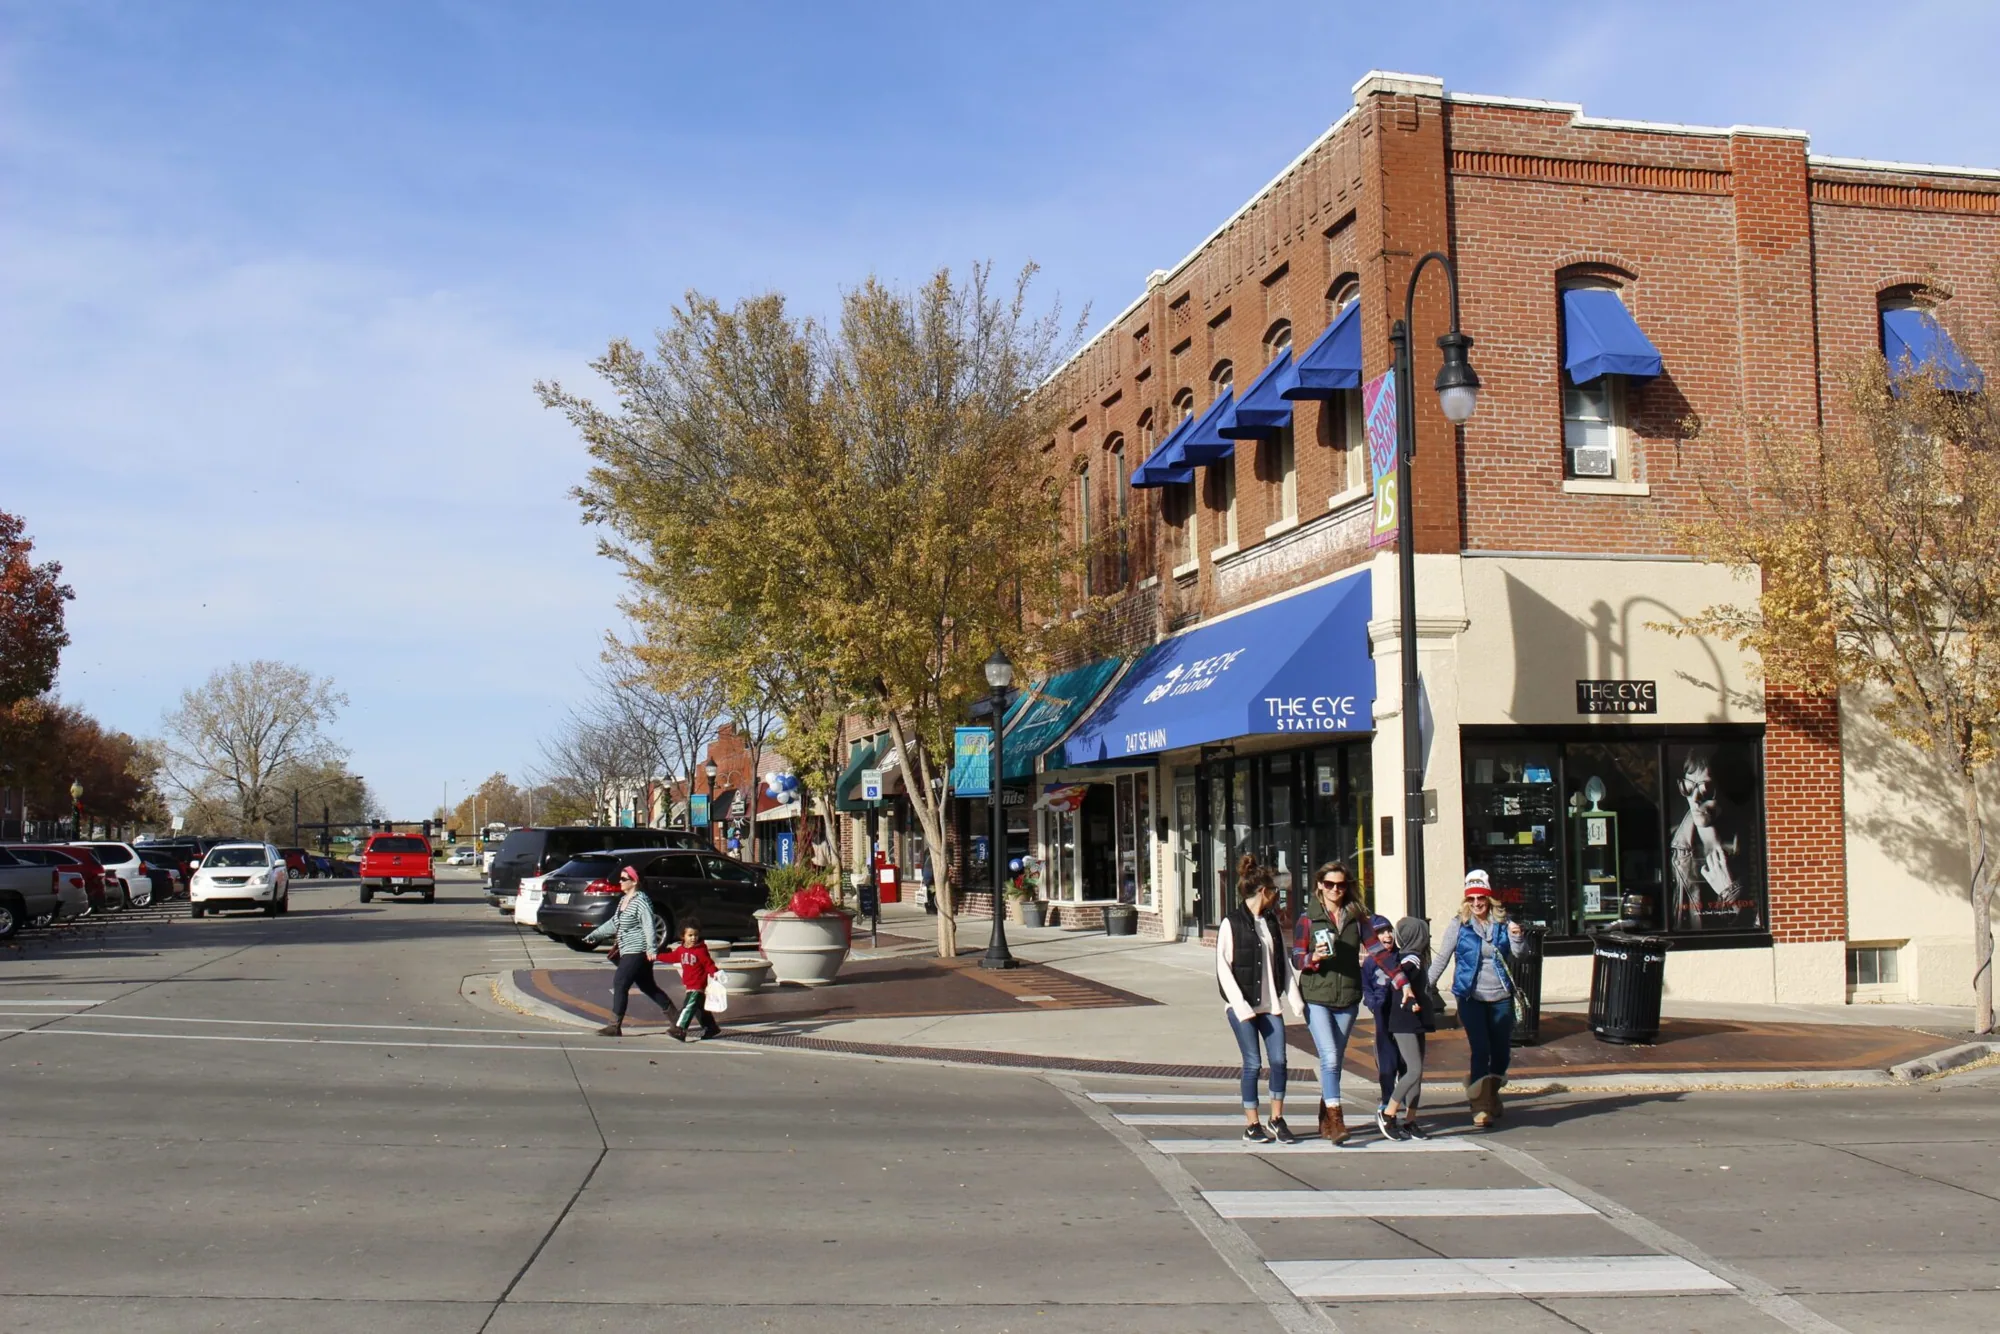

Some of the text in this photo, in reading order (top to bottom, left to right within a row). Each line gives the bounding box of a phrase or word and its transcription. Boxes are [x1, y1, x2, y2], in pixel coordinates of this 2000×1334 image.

[1369, 382, 1396, 453] DOWN
[1377, 479, 1395, 529] LS
[1180, 648, 1246, 682] THE EYE
[1169, 675, 1218, 697] STATION
[1578, 683, 1655, 699] THE EYE
[1264, 696, 1356, 717] THE EYE
[1589, 701, 1647, 711] STATION
[1276, 717, 1348, 731] STATION
[1125, 728, 1167, 753] 247 SE MAIN
